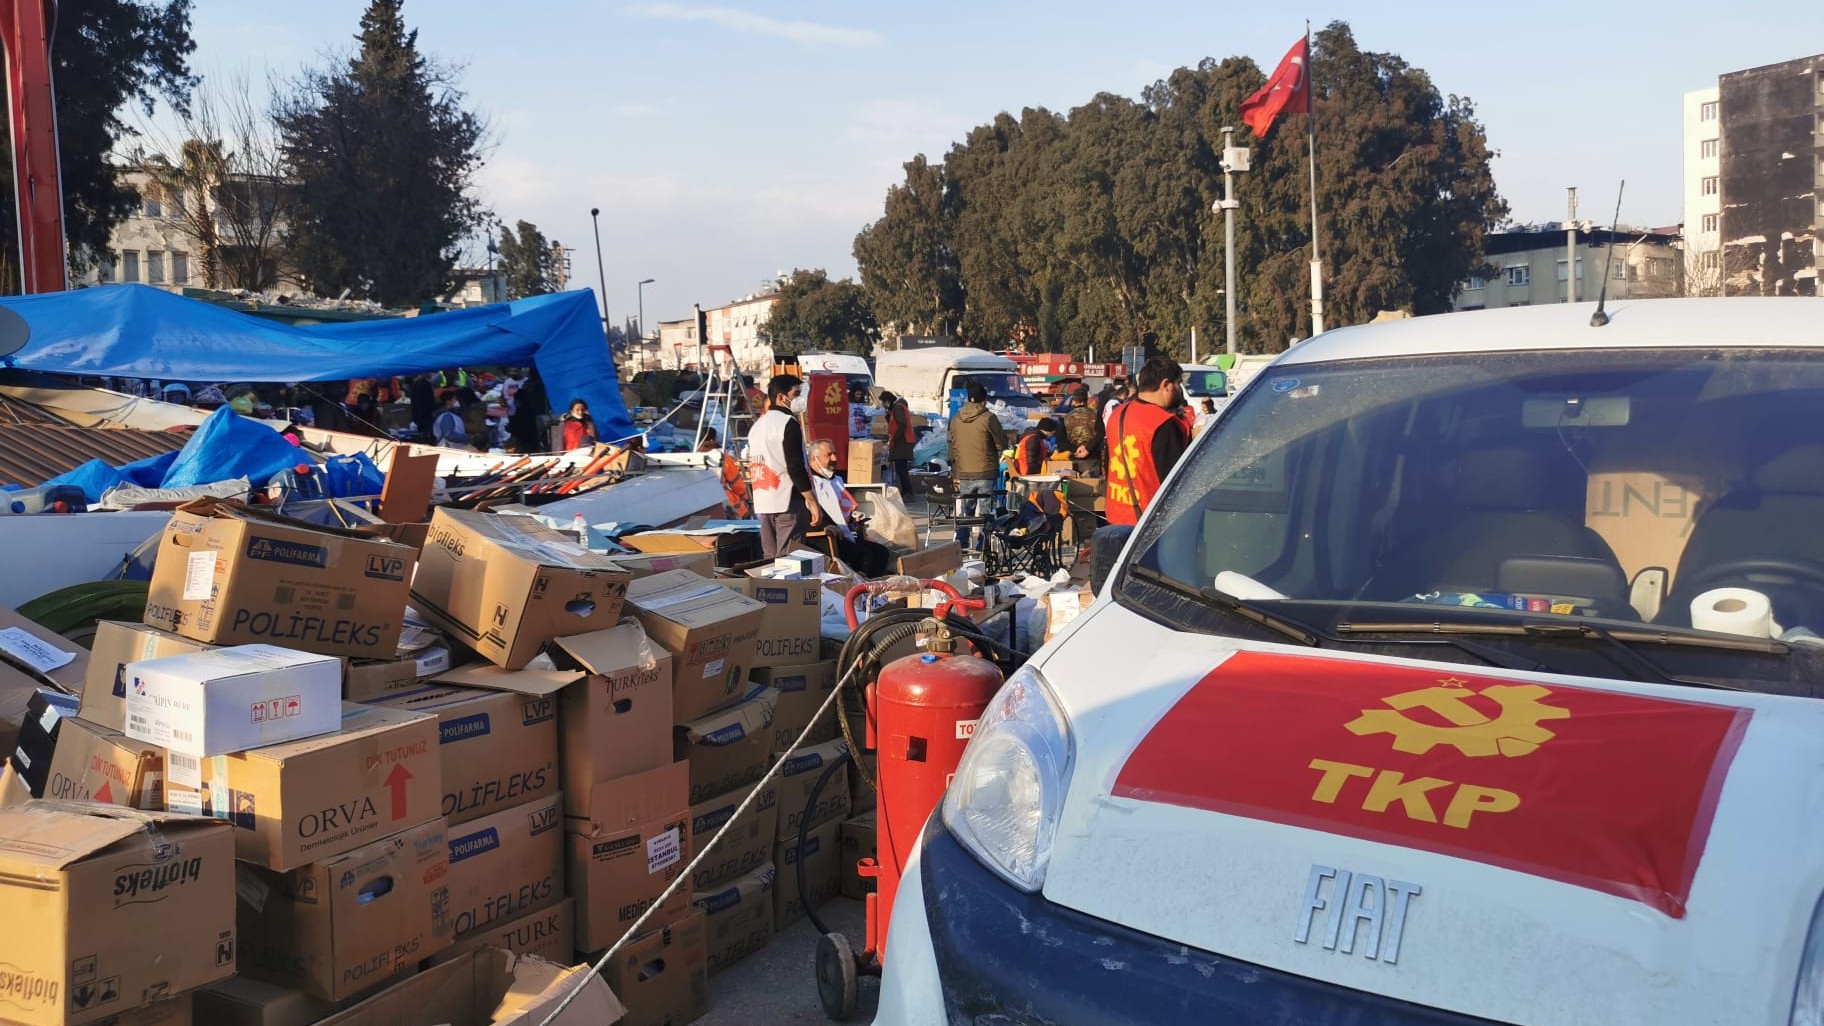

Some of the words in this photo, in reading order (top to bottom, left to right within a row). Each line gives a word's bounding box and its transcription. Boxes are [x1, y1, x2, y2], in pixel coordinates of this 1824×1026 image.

[824, 406, 842, 416] TKP
[428, 523, 466, 557] biofleks
[274, 547, 321, 563] POLİFARMA
[369, 556, 403, 575] LVP
[803, 589, 817, 601] LVP
[233, 608, 381, 647] POLİFLEKS
[524, 700, 553, 721] LVP
[443, 719, 485, 738] POLİFARMA
[960, 723, 977, 735] TO
[442, 766, 545, 816] OLİFLEKS
[1308, 758, 1521, 830] TKP
[298, 795, 378, 840] ORVA
[530, 807, 557, 831] LVP
[453, 835, 495, 856] POLİFARMA
[113, 856, 202, 897] biofleks
[450, 876, 551, 937] OLİFLEKS
[1295, 864, 1422, 965] FIAT
